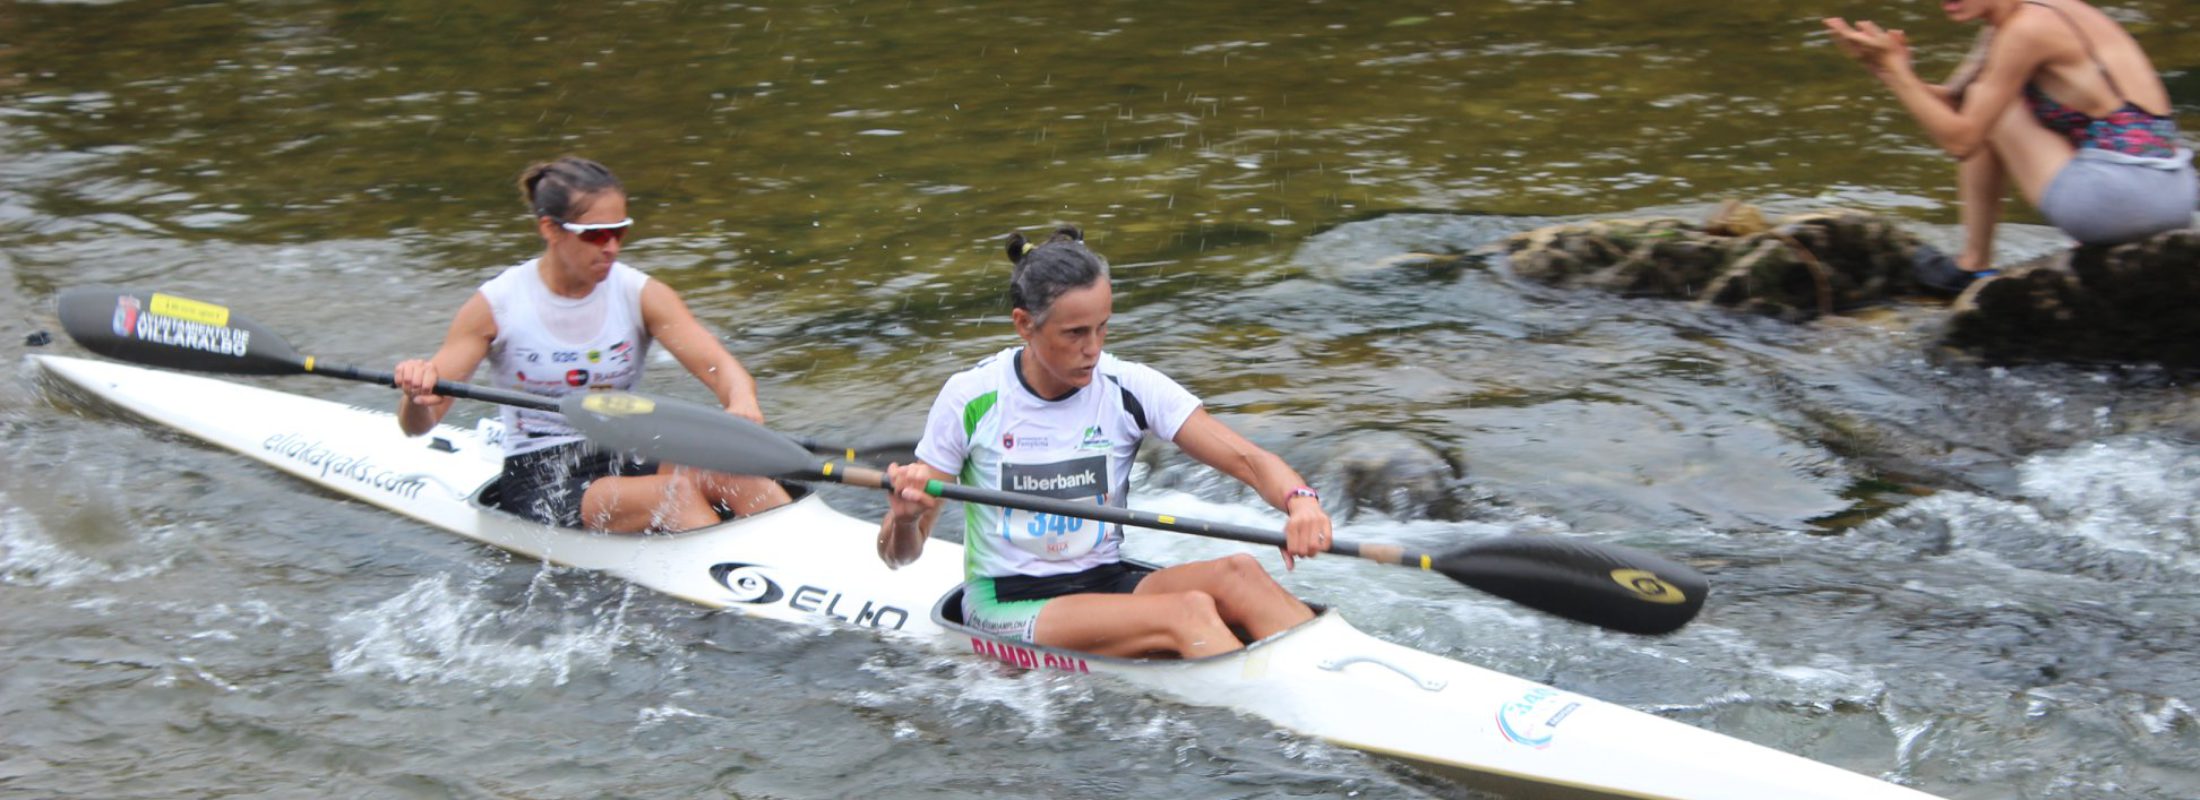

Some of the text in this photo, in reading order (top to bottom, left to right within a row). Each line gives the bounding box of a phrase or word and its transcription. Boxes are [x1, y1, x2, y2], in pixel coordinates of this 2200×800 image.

[233, 328, 249, 344] DE
[1013, 469, 1097, 491] Liberbank
[789, 585, 909, 630] ELIO
